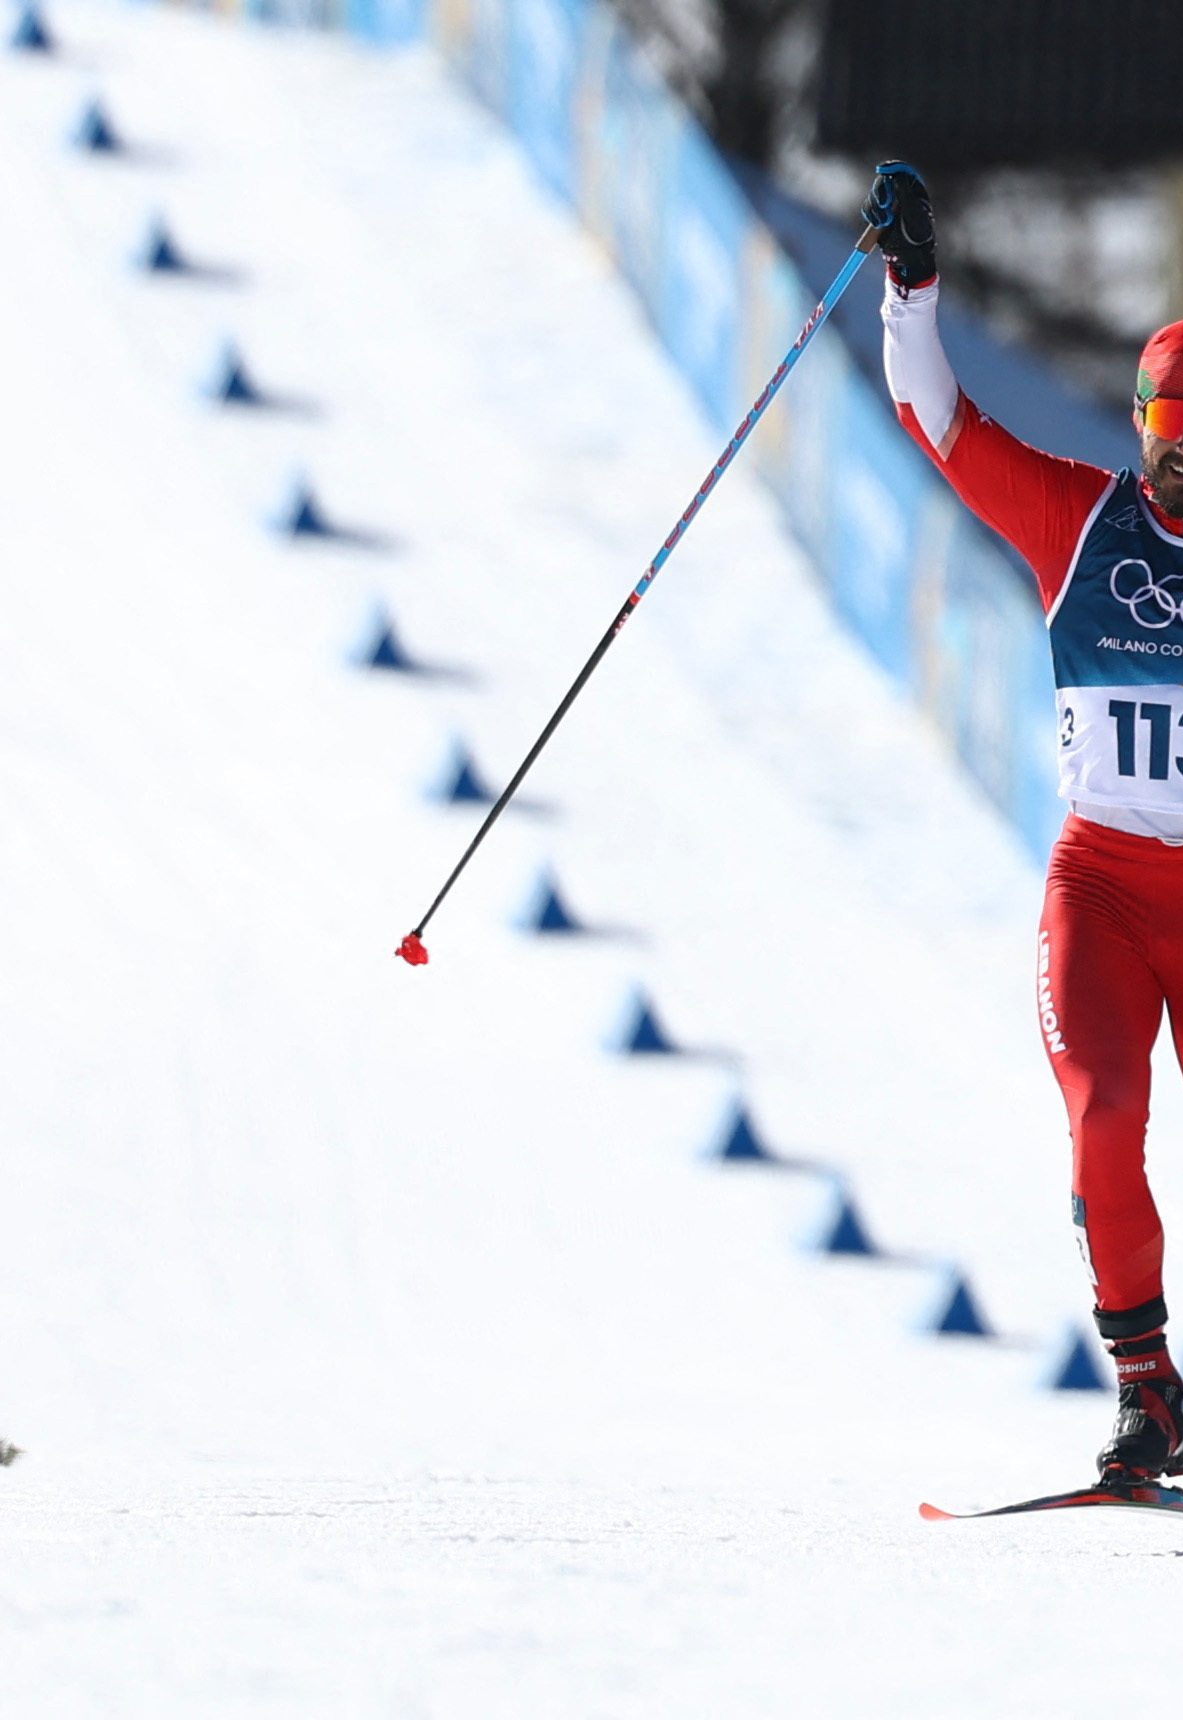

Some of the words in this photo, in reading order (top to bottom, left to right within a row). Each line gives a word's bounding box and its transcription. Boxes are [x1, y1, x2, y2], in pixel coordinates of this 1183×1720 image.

[1096, 636, 1158, 654] MILANO
[1039, 930, 1067, 1054] LEBANON
[1117, 1360, 1156, 1374] DSHUS
